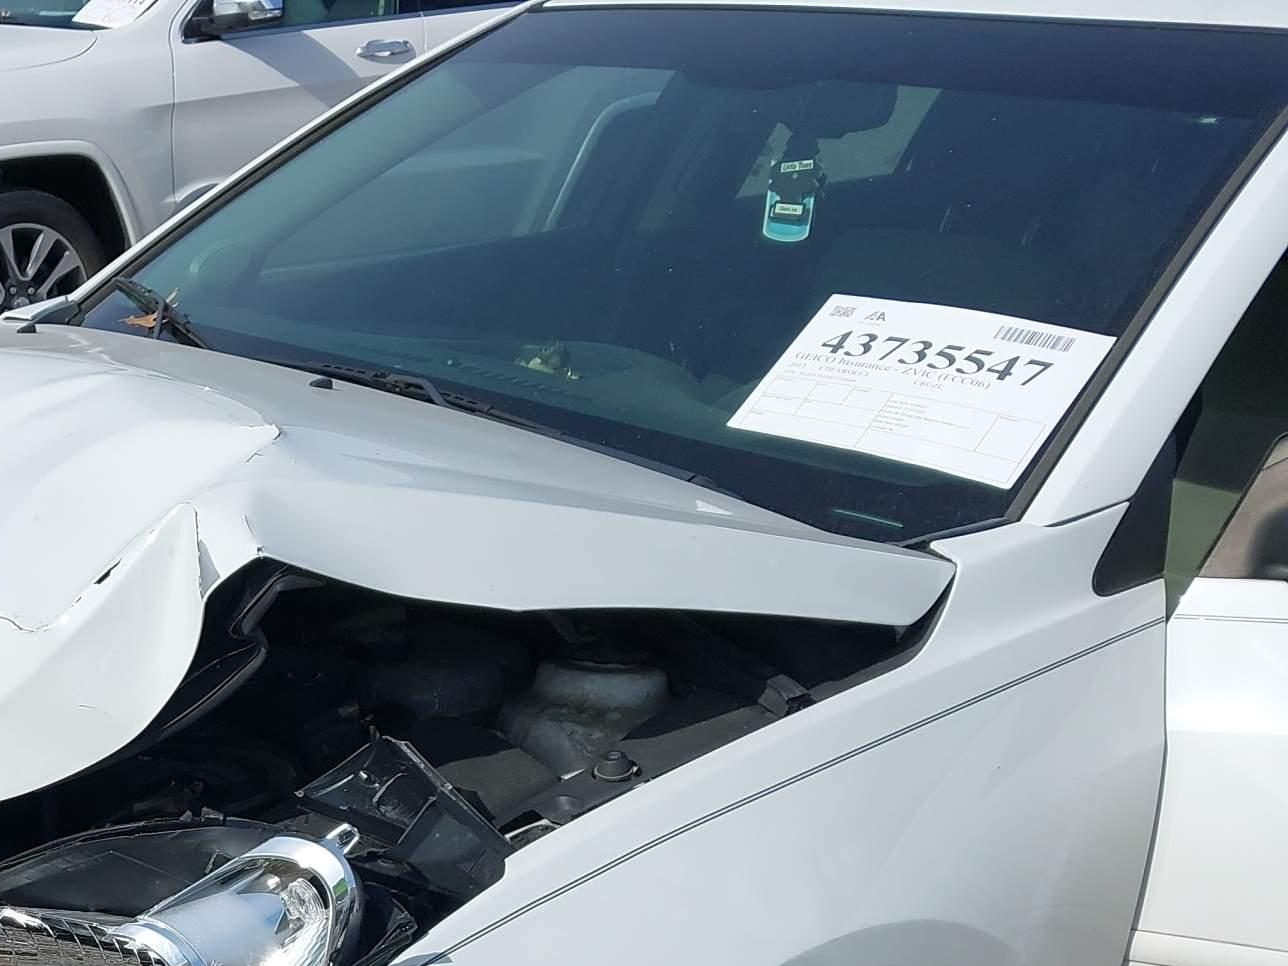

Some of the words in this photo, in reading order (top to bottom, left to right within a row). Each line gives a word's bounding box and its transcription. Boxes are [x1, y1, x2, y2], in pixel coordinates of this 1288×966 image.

[795, 352, 837, 363] GEICO
[838, 357, 892, 372] Insurance
[821, 330, 1055, 386] 43735547
